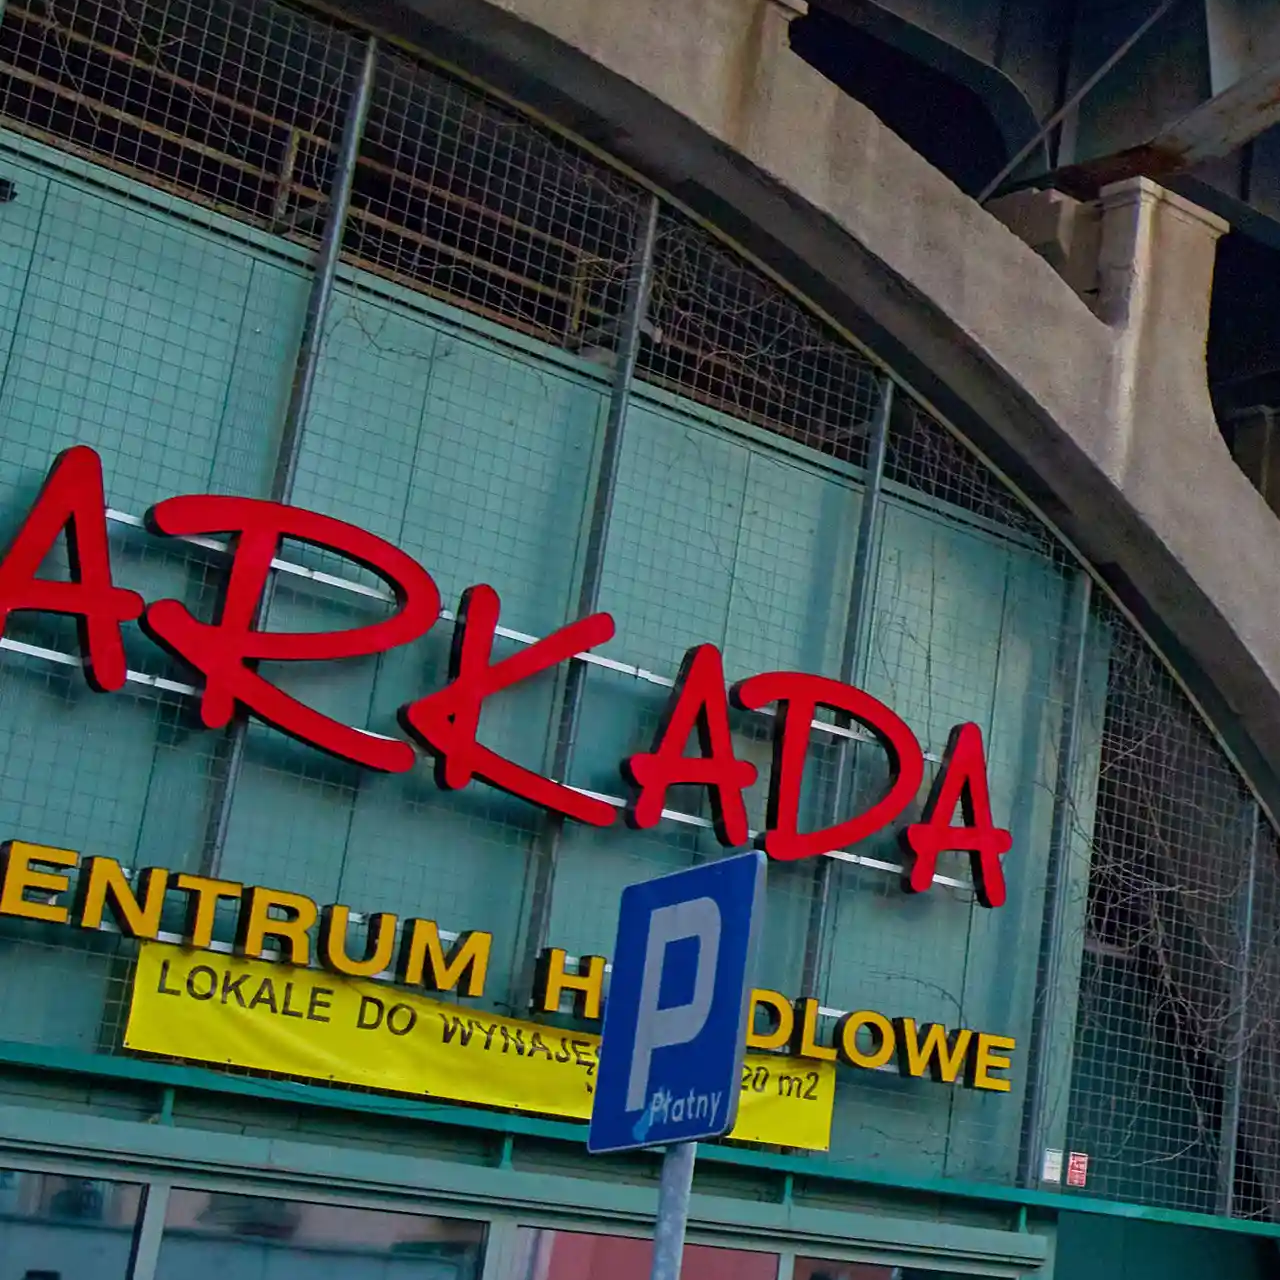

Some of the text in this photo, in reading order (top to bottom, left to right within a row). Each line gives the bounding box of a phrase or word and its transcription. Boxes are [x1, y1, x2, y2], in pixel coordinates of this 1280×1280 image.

[0, 445, 1012, 908] ARKADA
[0, 839, 1017, 1092] ENTRUM HDLOWE
[157, 959, 335, 1023] LOKALE
[356, 995, 418, 1036] DO
[437, 1012, 601, 1076] WYNAJĘ
[778, 1071, 819, 1101] m2
[625, 896, 722, 1113] P
[648, 1086, 722, 1128] Płatny
